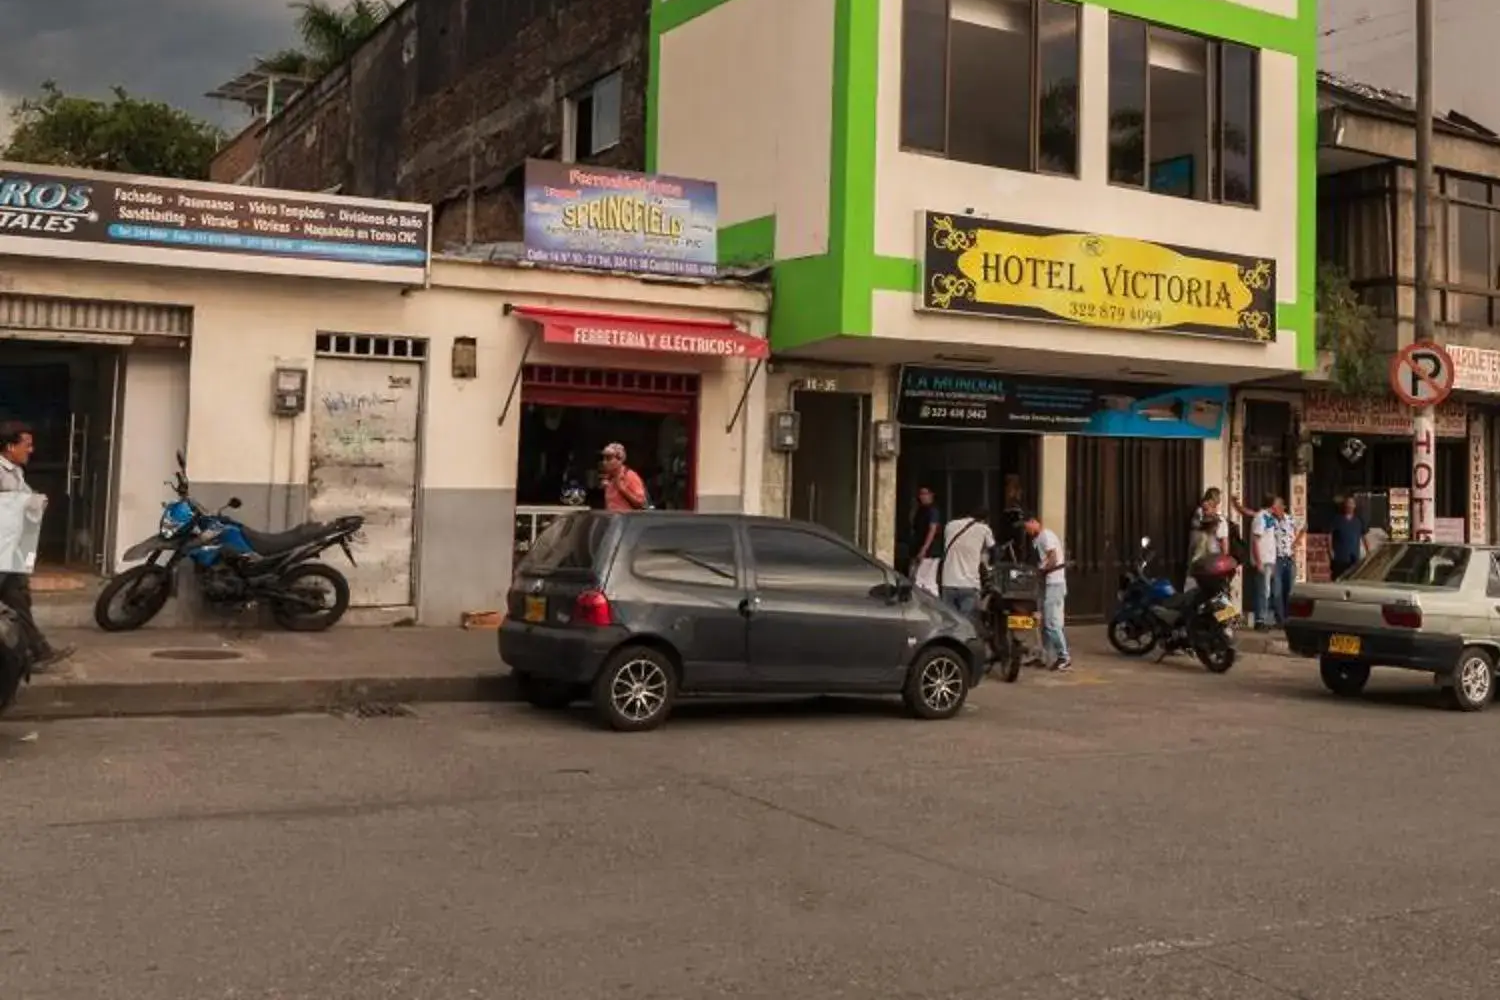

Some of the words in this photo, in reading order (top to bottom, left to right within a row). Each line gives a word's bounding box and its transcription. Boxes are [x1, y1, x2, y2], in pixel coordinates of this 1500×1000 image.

[0, 178, 93, 211] ROS
[114, 188, 163, 205] Fachadas
[339, 210, 385, 224] Divisiones
[386, 214, 398, 227] de
[119, 206, 186, 227] Sandblasting
[562, 195, 684, 237] SPRINGFIELD
[982, 252, 1084, 293] HOTEL
[1102, 263, 1233, 309] VICTORIA
[1069, 301, 1096, 317] 322
[1100, 305, 1125, 321] 879
[1411, 352, 1441, 396] P
